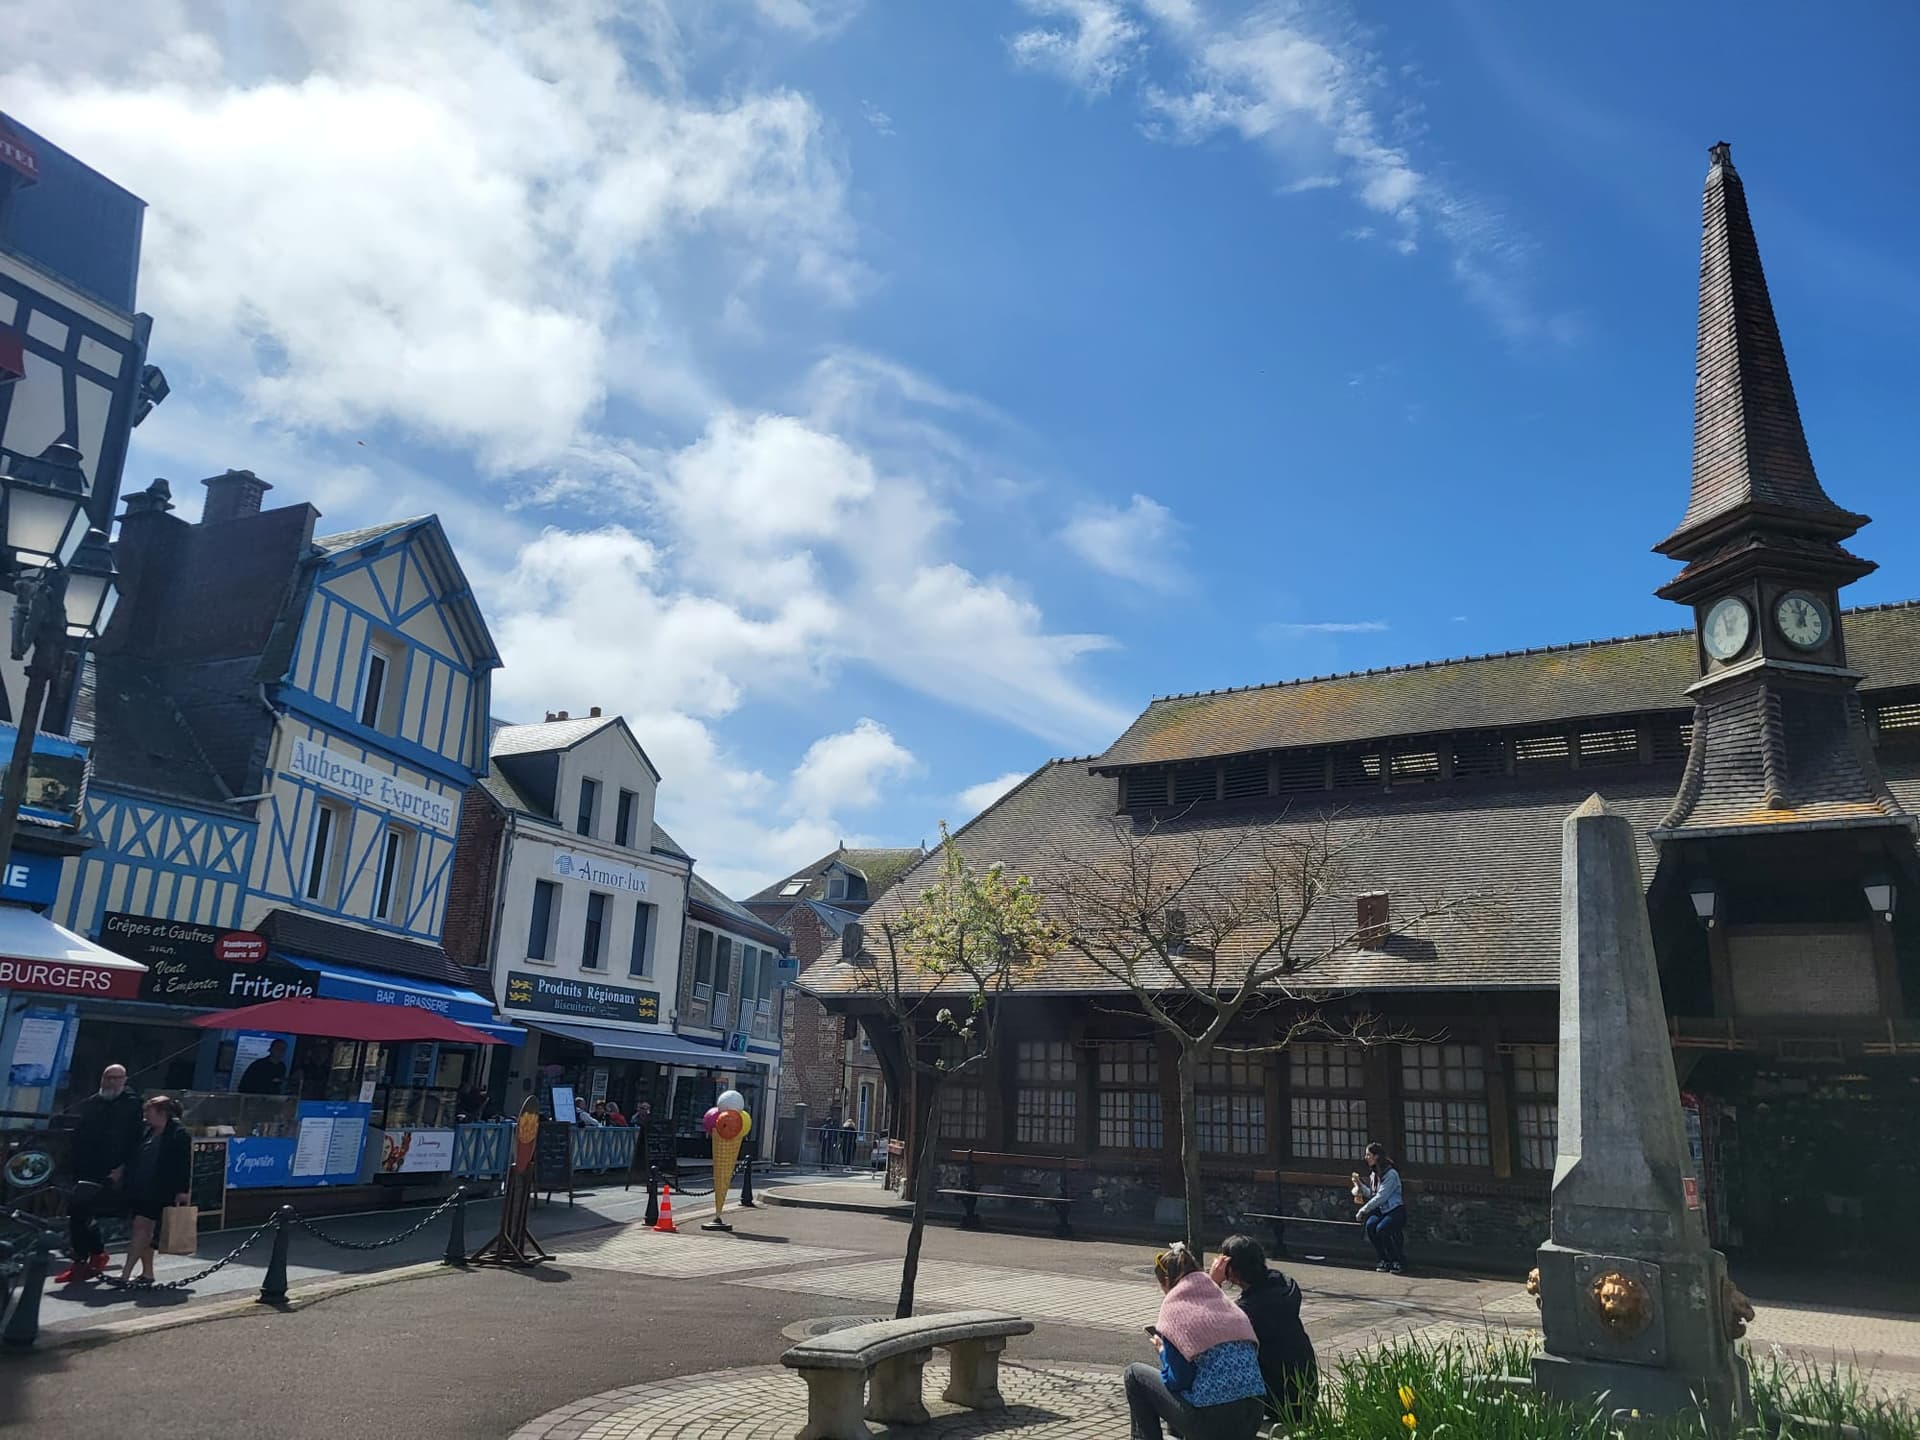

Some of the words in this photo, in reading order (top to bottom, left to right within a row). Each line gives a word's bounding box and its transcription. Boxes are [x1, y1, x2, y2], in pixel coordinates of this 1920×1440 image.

[291, 741, 374, 797] Auberge
[379, 776, 450, 827] Express
[107, 916, 151, 938] Crêpes
[152, 925, 167, 937] et
[168, 925, 215, 943] Gaufres
[0, 962, 112, 990] BURGERS
[154, 960, 187, 975] Vente
[229, 972, 313, 999] Friterie
[537, 979, 582, 998] Produits
[587, 985, 636, 1005] Régionaux
[376, 990, 396, 1004] BAR
[403, 993, 449, 1013] BRASSERIE
